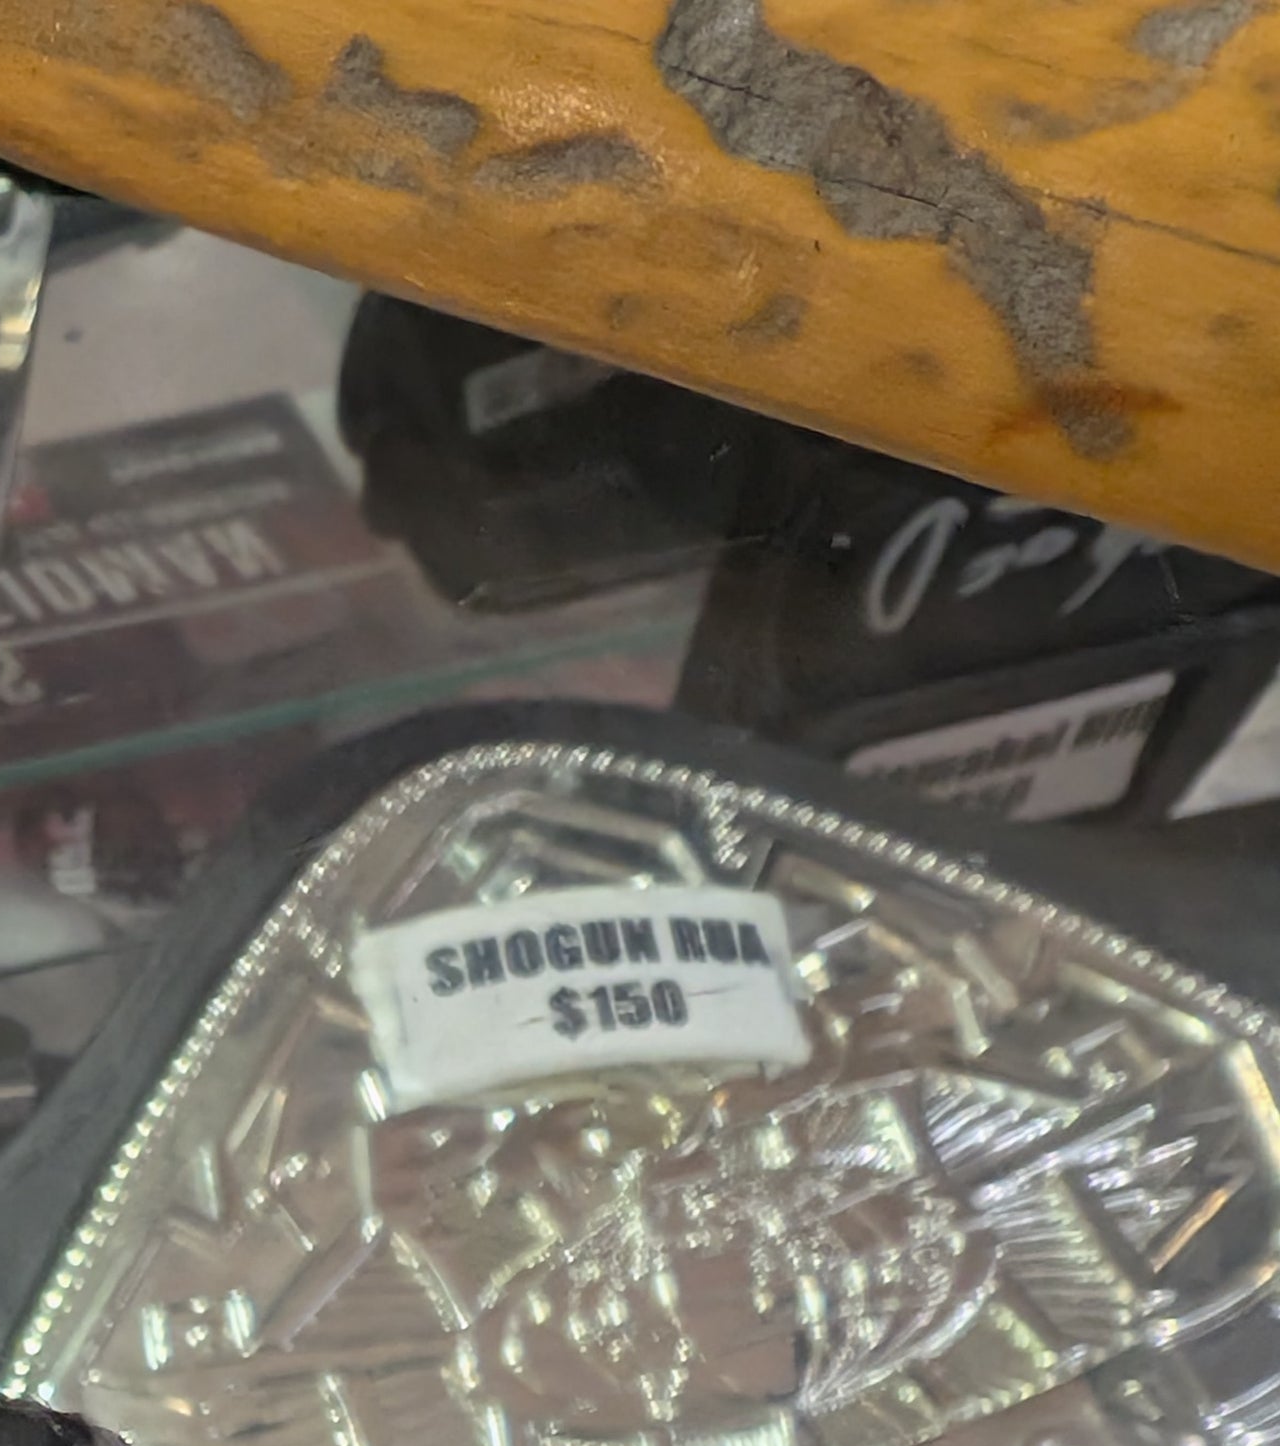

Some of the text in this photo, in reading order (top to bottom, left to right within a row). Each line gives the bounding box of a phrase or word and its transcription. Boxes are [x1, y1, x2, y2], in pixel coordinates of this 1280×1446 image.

[425, 917, 773, 998] SHOGUN RUA
[548, 979, 689, 1040] $150
